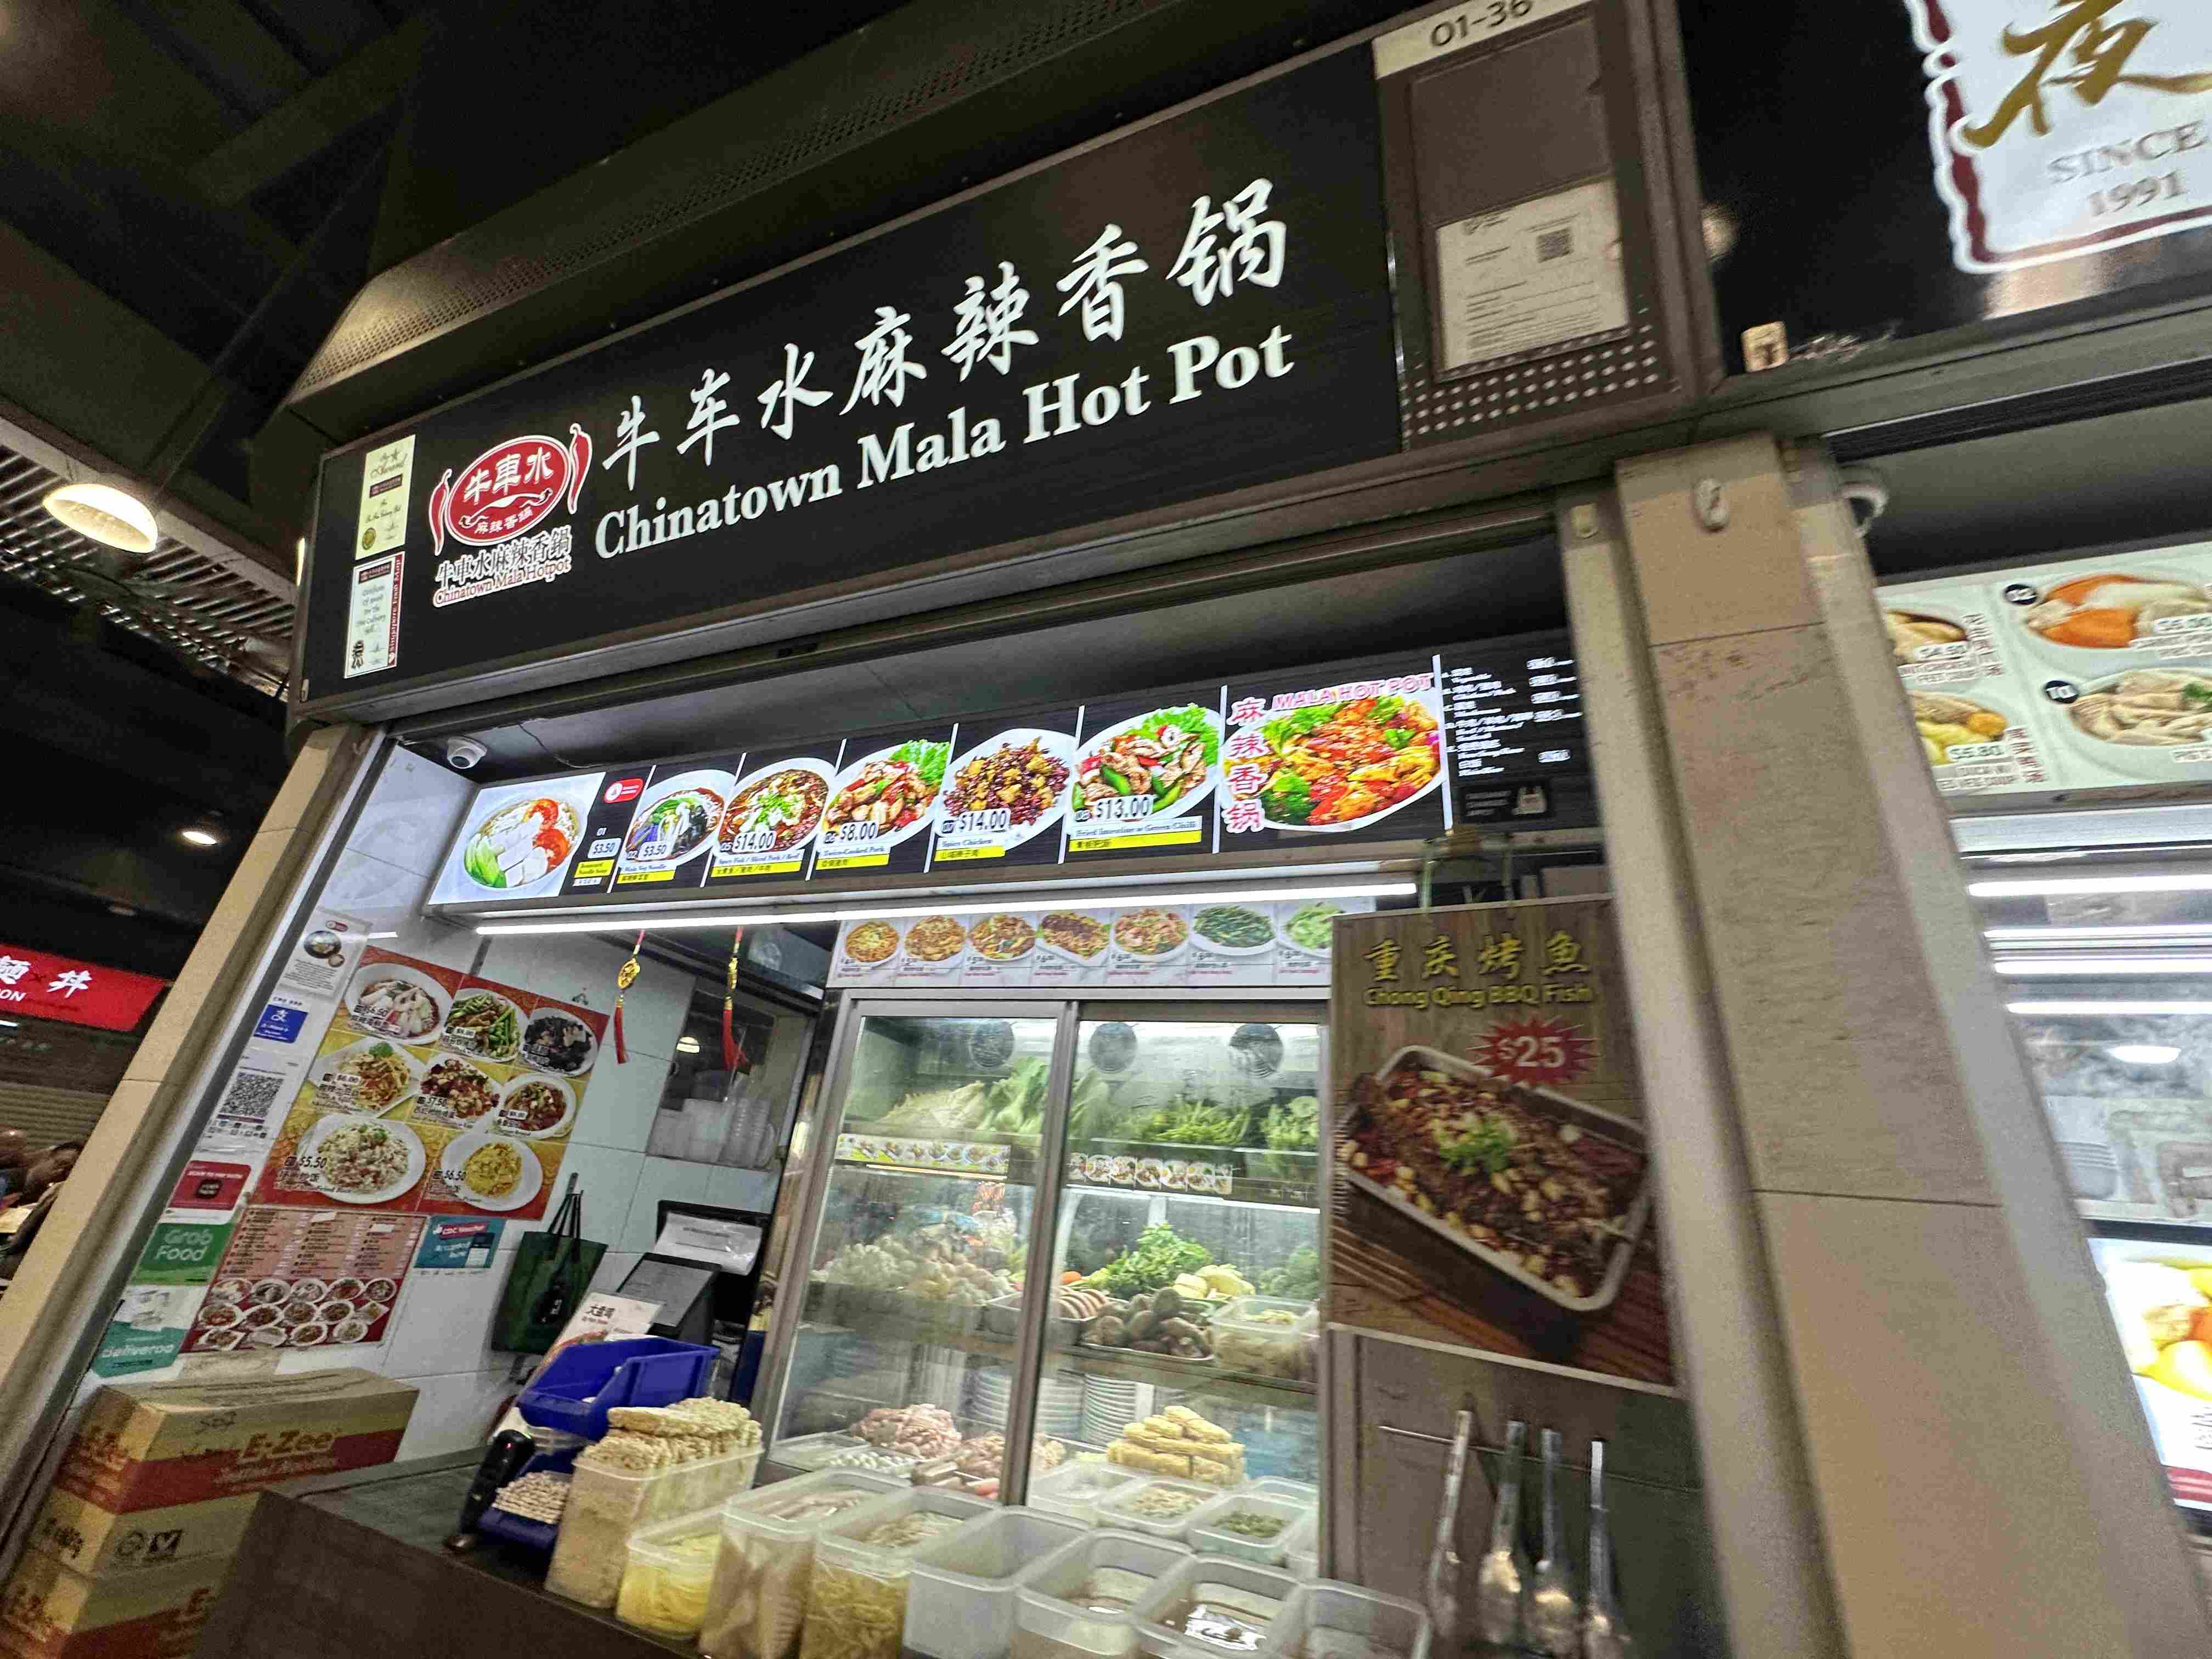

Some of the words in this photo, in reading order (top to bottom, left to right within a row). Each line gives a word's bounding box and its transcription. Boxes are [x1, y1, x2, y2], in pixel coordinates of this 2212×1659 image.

[1431, 0, 1532, 46] 01-36
[2047, 119, 2209, 184] SINCE
[2088, 167, 2187, 216] 1991
[601, 178, 1287, 492] 牛车水麻辣香锅
[595, 464, 842, 561] Chinatown
[857, 406, 1006, 489] Mala
[1022, 365, 1152, 445] Hot
[1167, 324, 1296, 405] Pot
[462, 447, 554, 505] 牛車水
[436, 580, 492, 604] Chinatown
[495, 570, 526, 589] Mala
[1273, 689, 1332, 709] MALA
[1339, 681, 1383, 699] HOT
[1388, 673, 1434, 692] POT
[959, 810, 1007, 832] $14.00
[1097, 797, 1151, 819] $13.00
[734, 832, 774, 850] $14.00
[840, 822, 876, 841] $8.00
[592, 842, 616, 855] $3.50
[643, 844, 668, 857] $3.50
[0, 988, 27, 1002] ON
[1498, 1035, 1566, 1068] $25
[298, 1156, 326, 1169] $5.50
[165, 1229, 212, 1246] Grab
